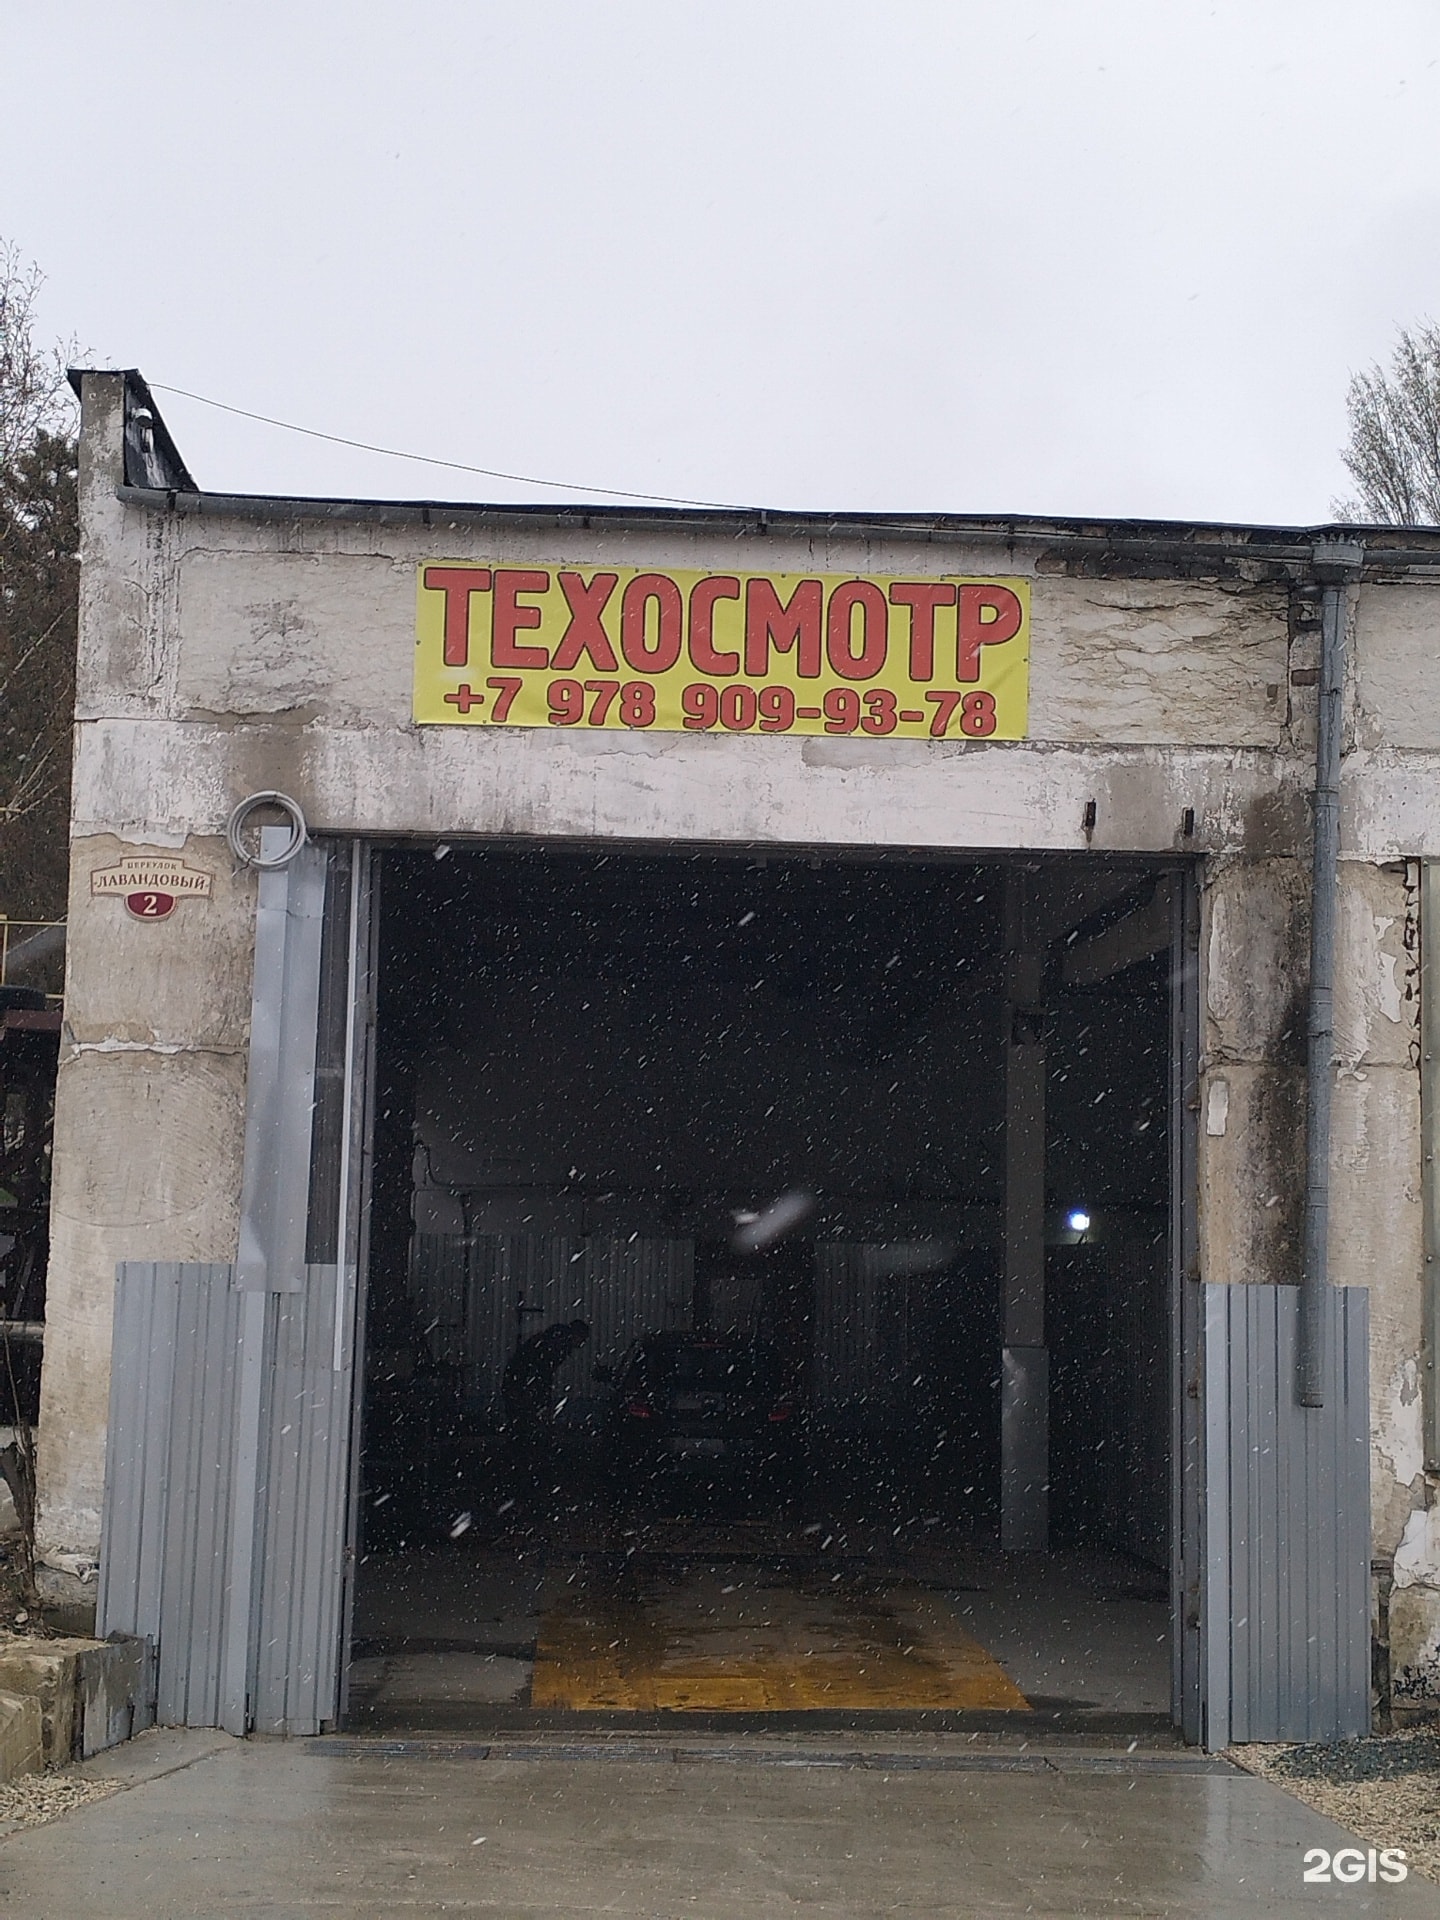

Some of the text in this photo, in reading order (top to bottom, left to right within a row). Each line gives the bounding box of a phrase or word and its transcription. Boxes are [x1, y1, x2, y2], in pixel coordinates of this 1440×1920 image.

[424, 567, 1023, 683] ТЕХОСМОТР
[444, 677, 997, 738] +7 978 909-93-78
[97, 873, 206, 890] ЛАВАНДОВЫЙ
[143, 895, 158, 914] 2
